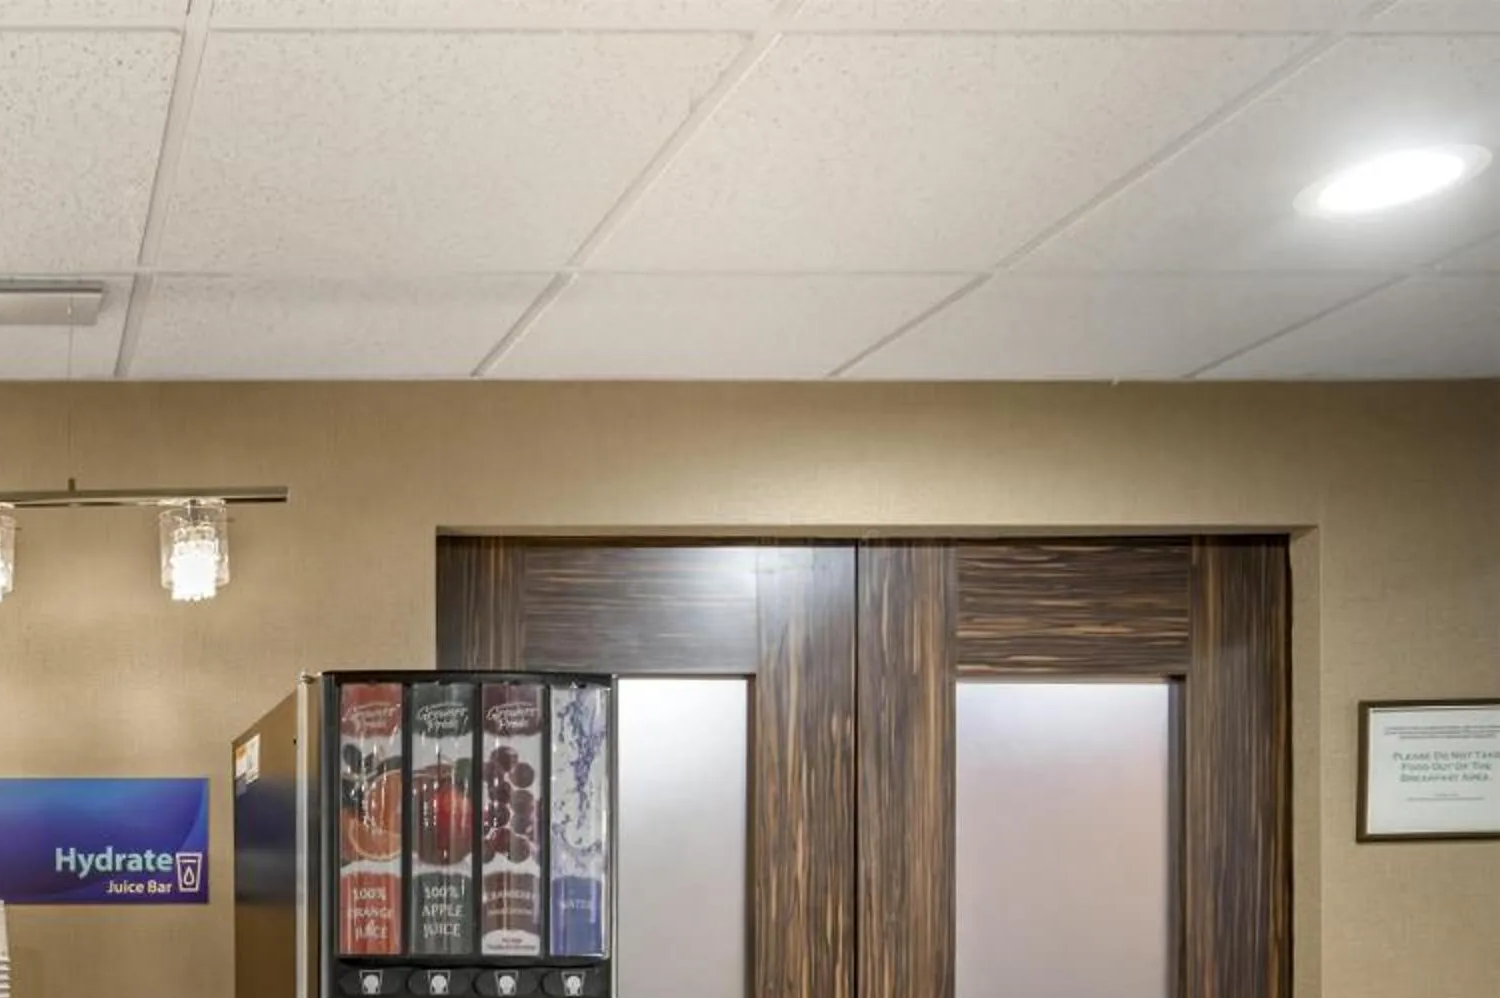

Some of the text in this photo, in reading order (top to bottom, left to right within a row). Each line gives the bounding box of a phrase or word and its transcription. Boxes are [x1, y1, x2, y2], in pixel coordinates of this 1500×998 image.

[55, 845, 173, 879] Hydrate
[106, 879, 172, 893] Juice Bar
[421, 904, 464, 918] APPLE
